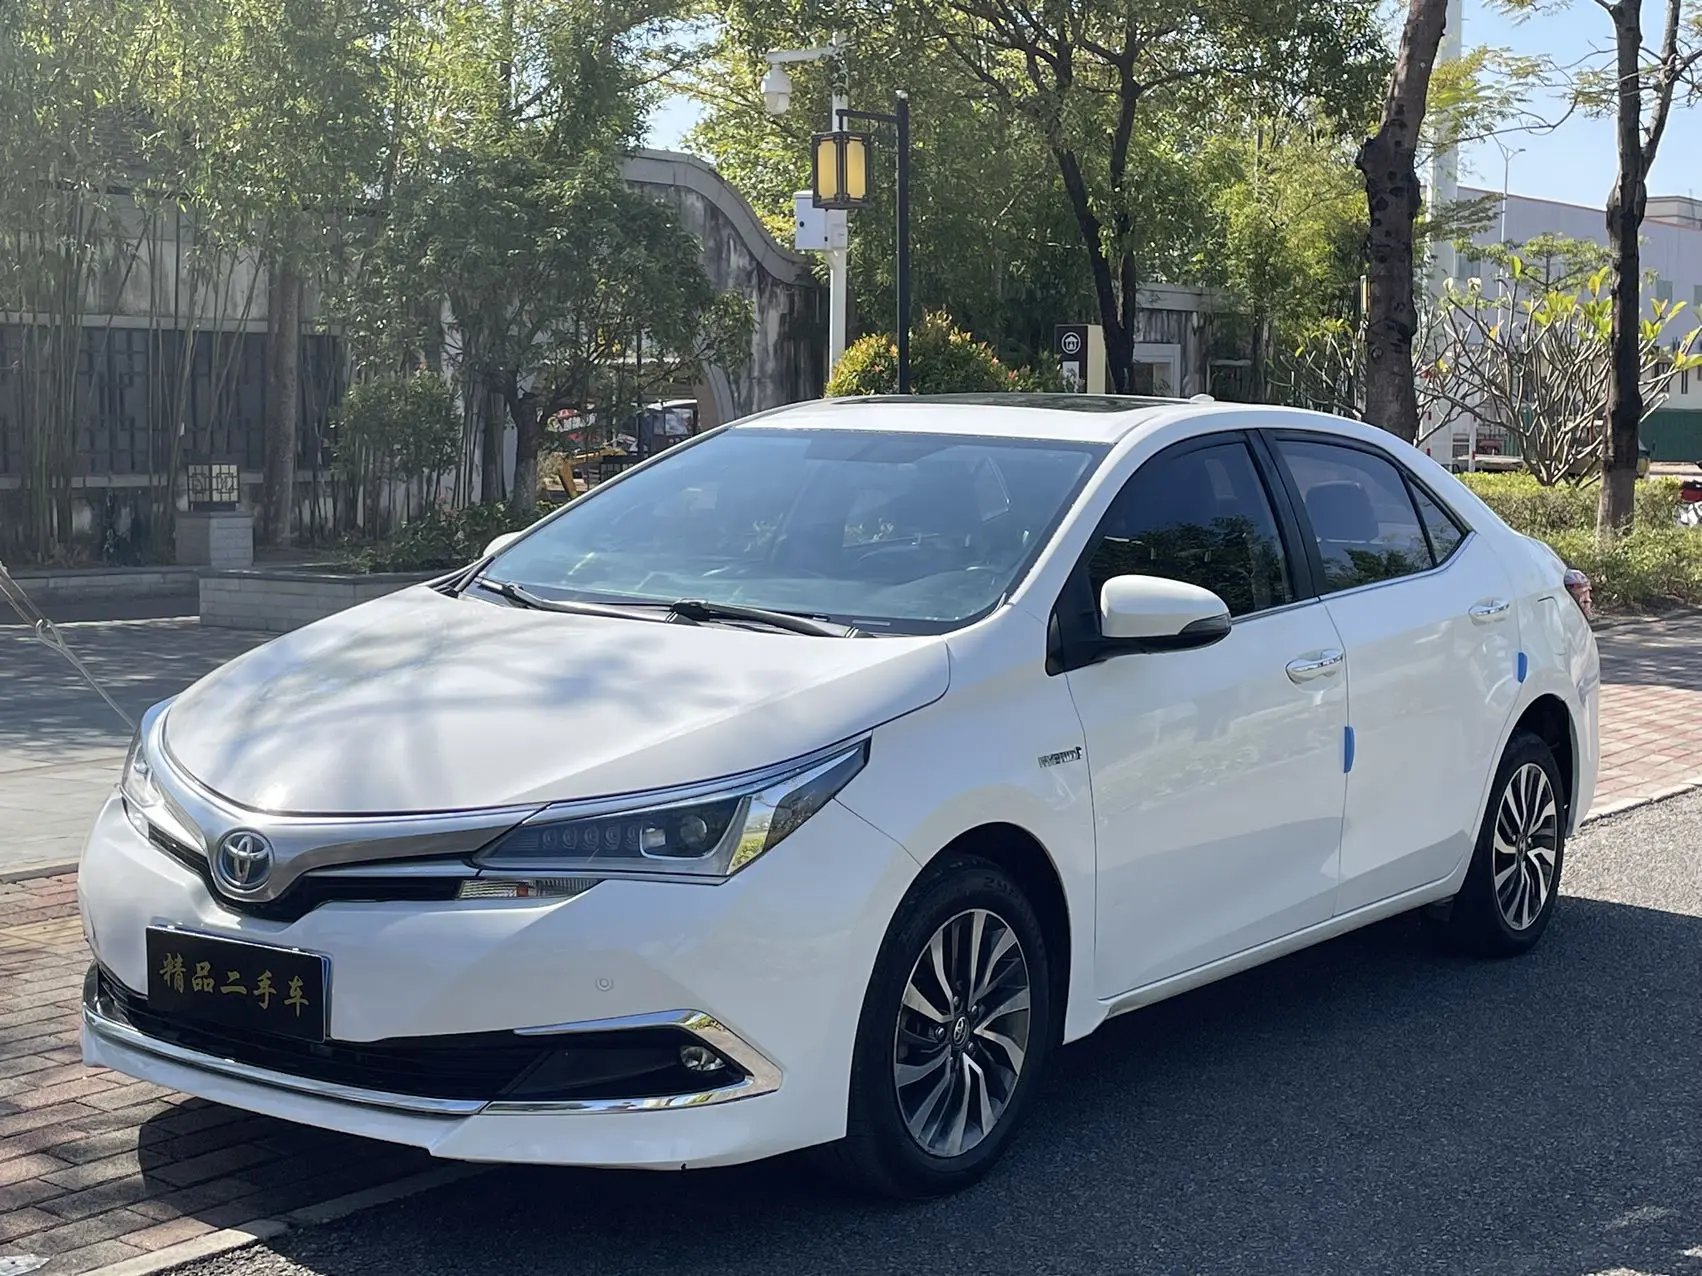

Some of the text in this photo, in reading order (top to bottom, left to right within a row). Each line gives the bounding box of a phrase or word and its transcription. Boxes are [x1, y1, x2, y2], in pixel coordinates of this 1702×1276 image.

[159, 953, 310, 1017] 精品二手车
